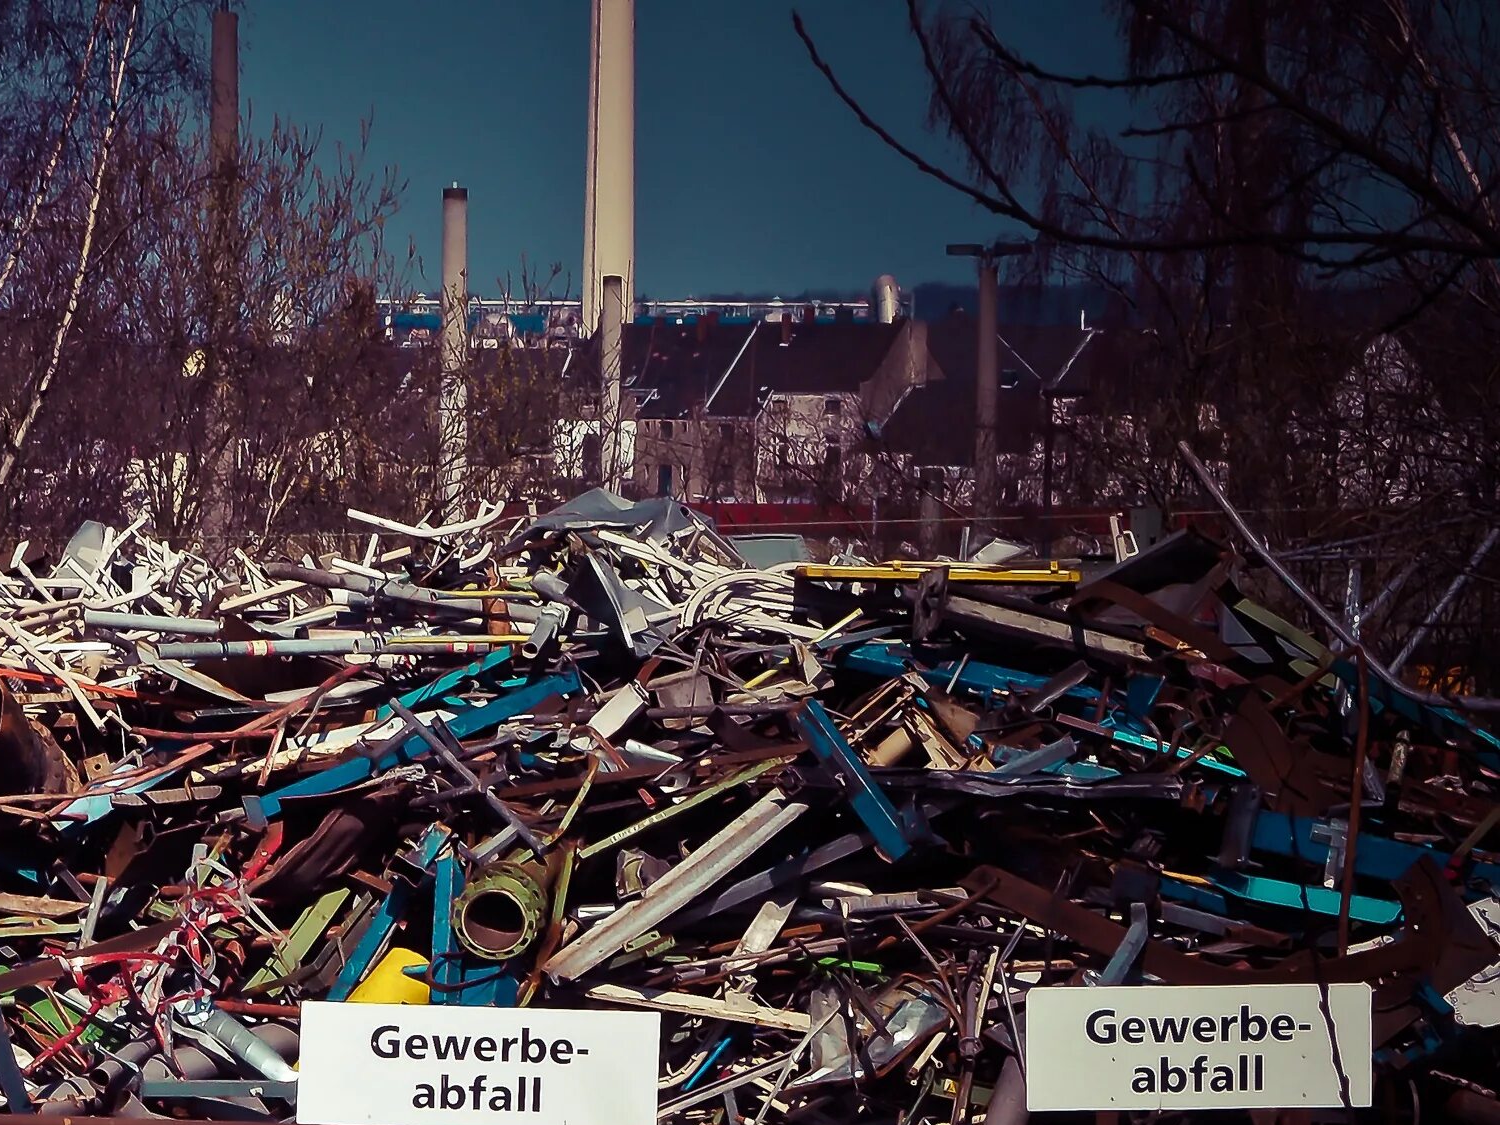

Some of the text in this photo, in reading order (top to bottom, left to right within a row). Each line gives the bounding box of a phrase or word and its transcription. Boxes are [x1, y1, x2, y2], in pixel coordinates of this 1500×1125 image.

[1085, 1005, 1312, 1045] Gewerbe-
[370, 1025, 590, 1065] Gewerbe-
[1131, 1054, 1265, 1093] abfall
[412, 1074, 542, 1113] abfall
